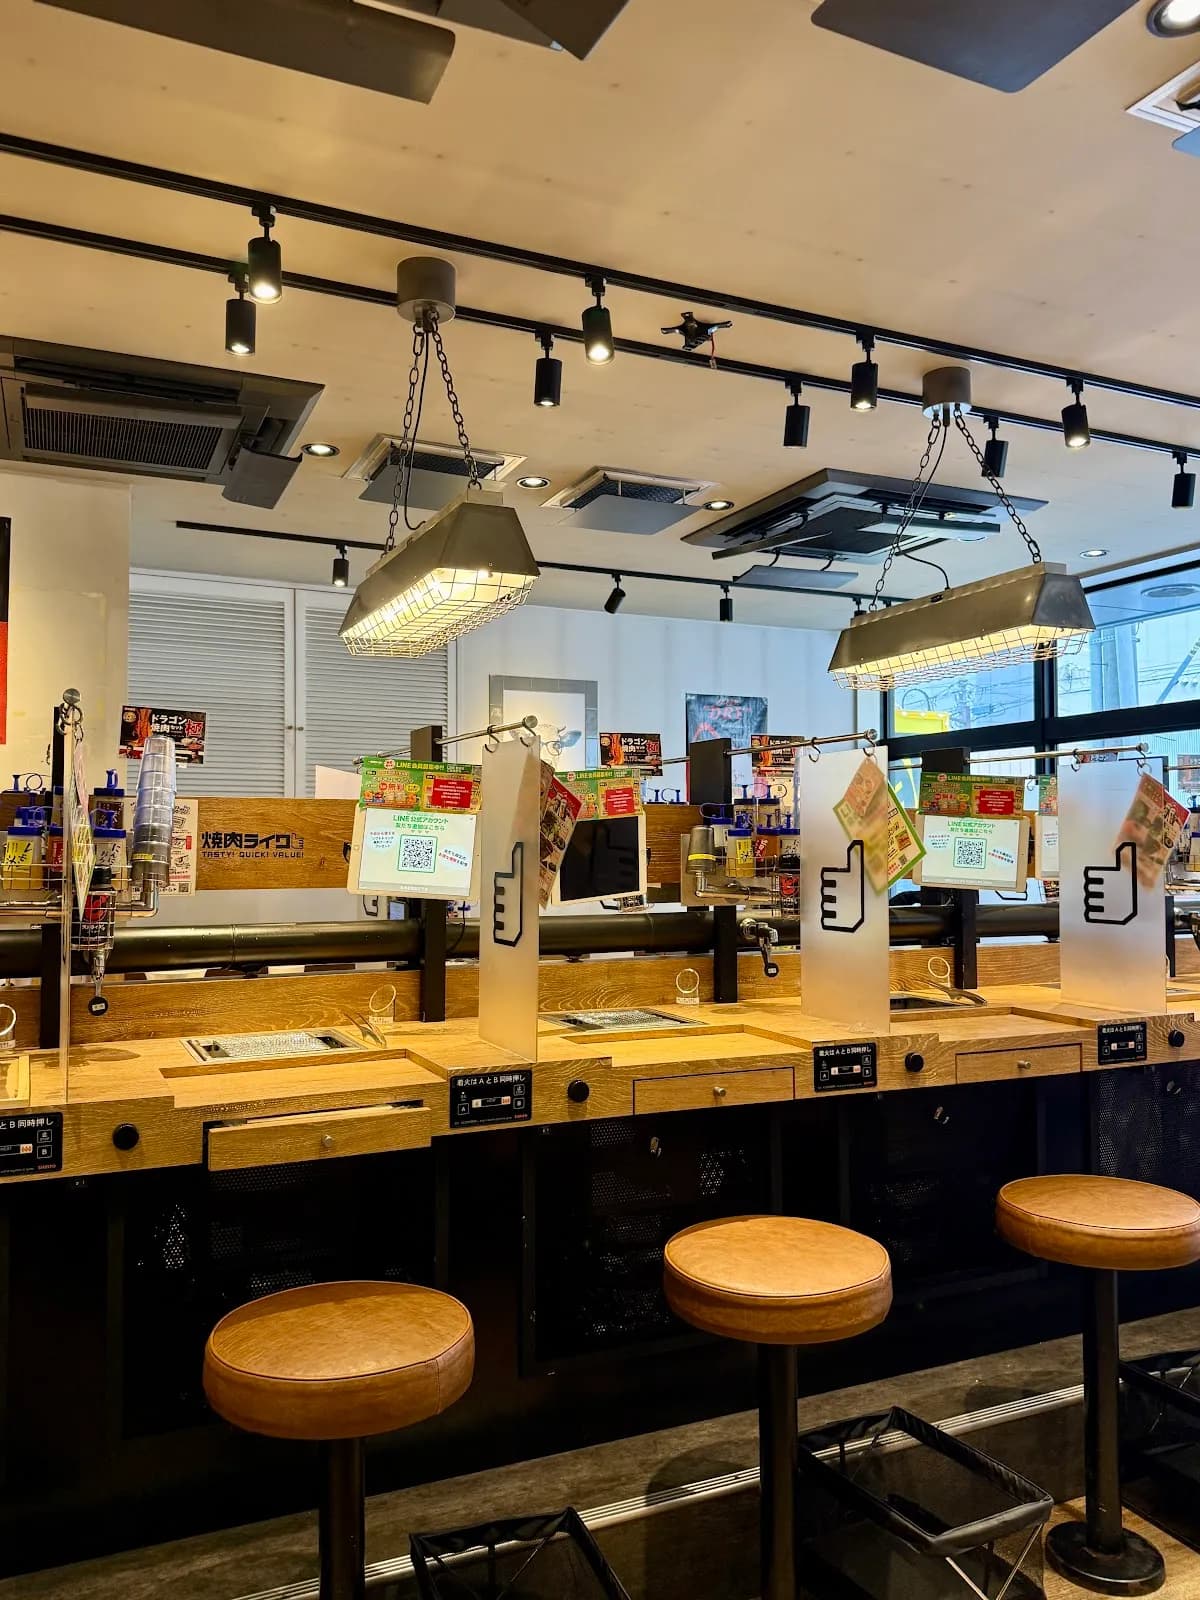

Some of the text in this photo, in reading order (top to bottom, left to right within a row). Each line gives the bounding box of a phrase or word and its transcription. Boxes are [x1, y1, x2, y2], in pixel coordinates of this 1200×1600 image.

[152, 714, 187, 725] ドラゴン
[621, 737, 648, 746] ドラゴン
